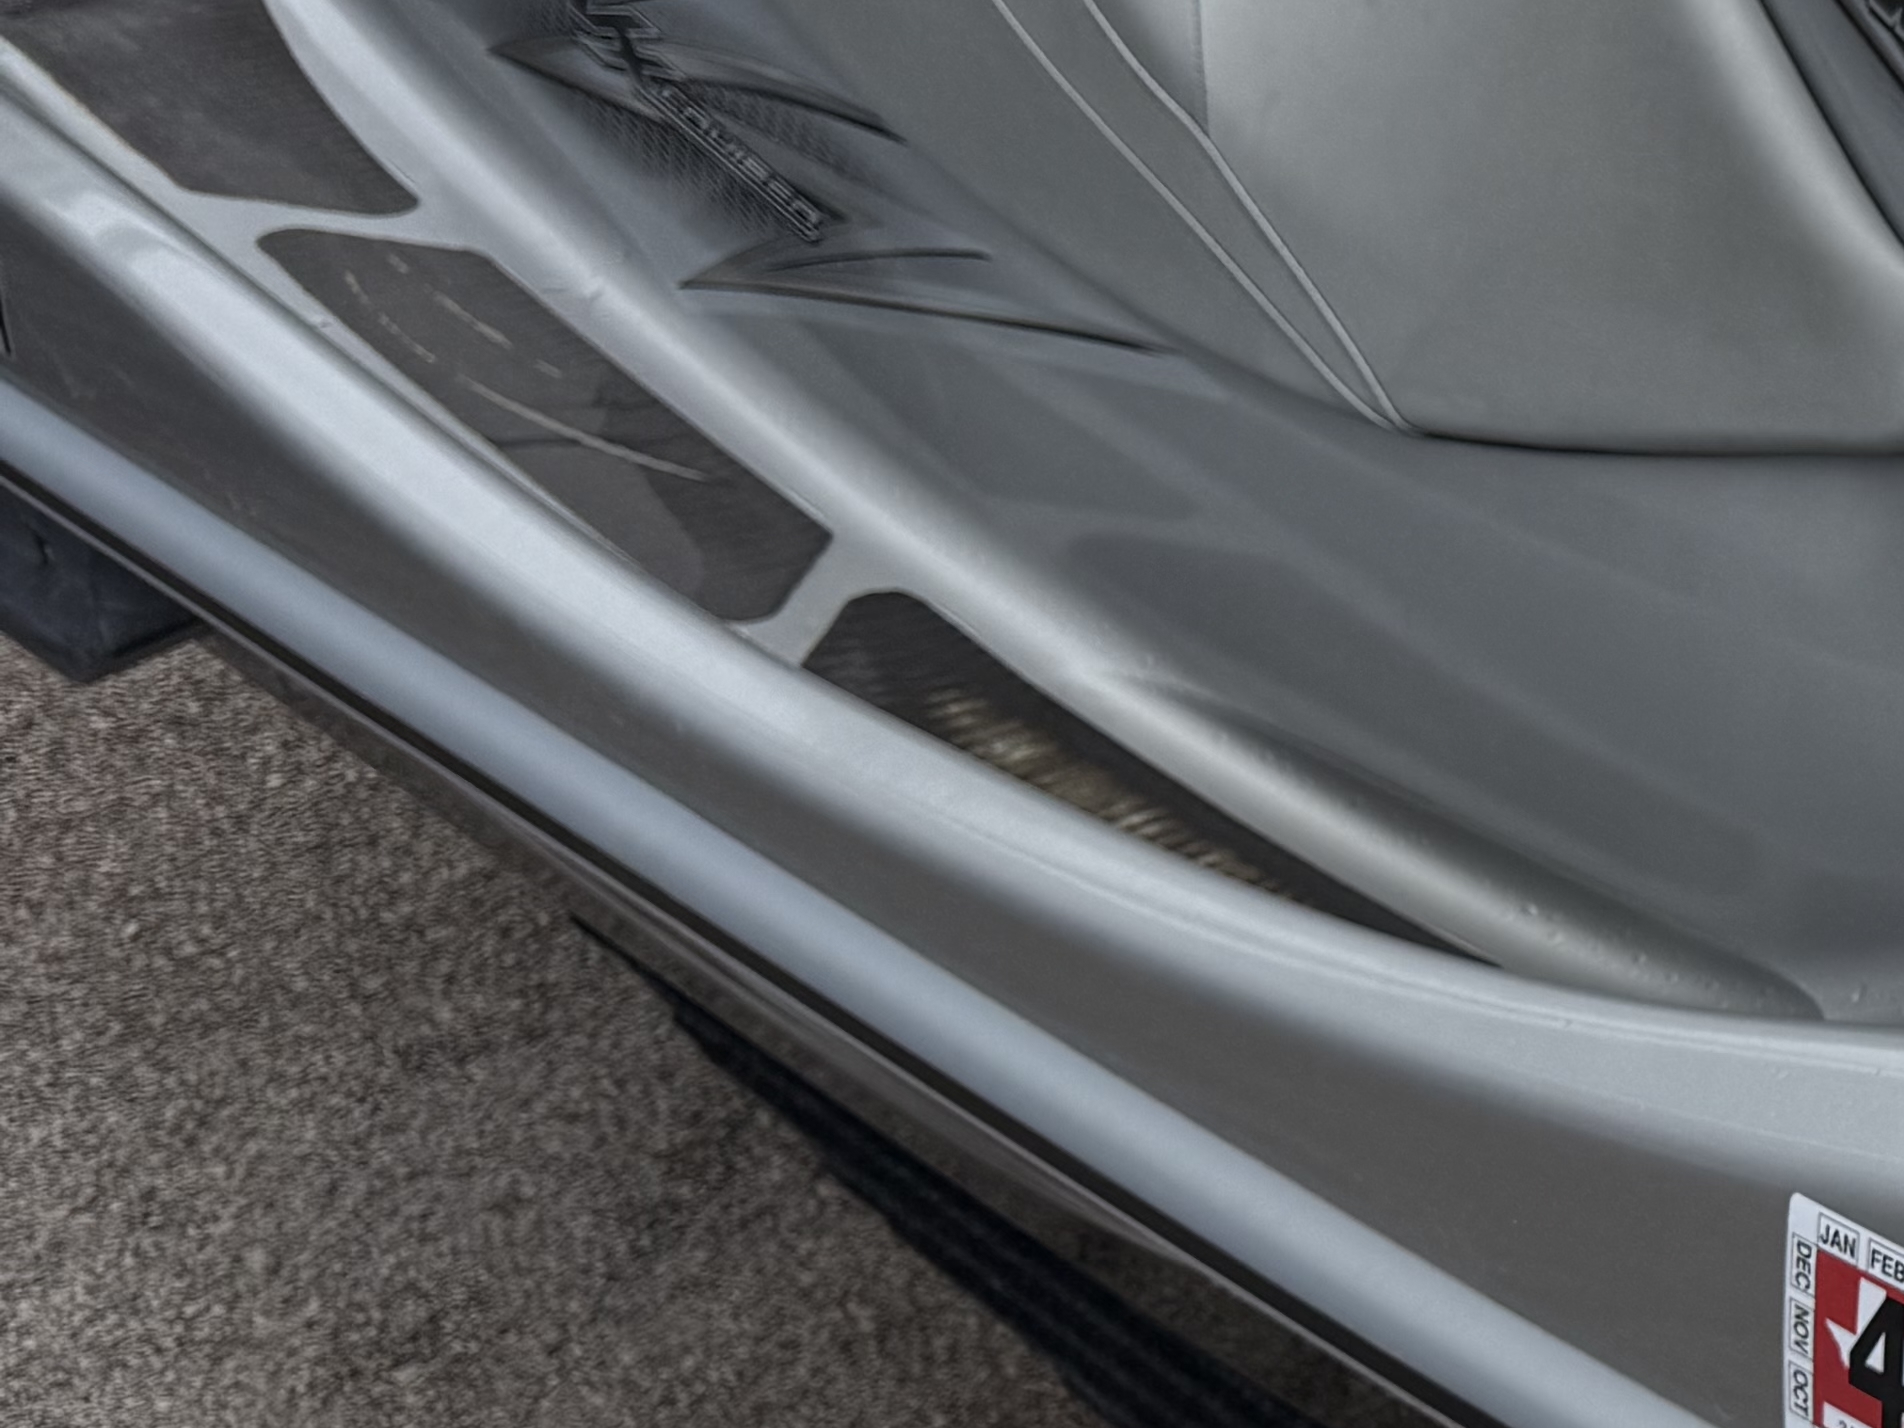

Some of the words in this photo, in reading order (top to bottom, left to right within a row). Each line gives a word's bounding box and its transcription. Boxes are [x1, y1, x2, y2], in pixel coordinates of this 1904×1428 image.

[1795, 1240, 1812, 1292] DEC
[1820, 1225, 1857, 1260] JAN
[1793, 1305, 1811, 1356] NOV
[1791, 1369, 1810, 1418] OCT
